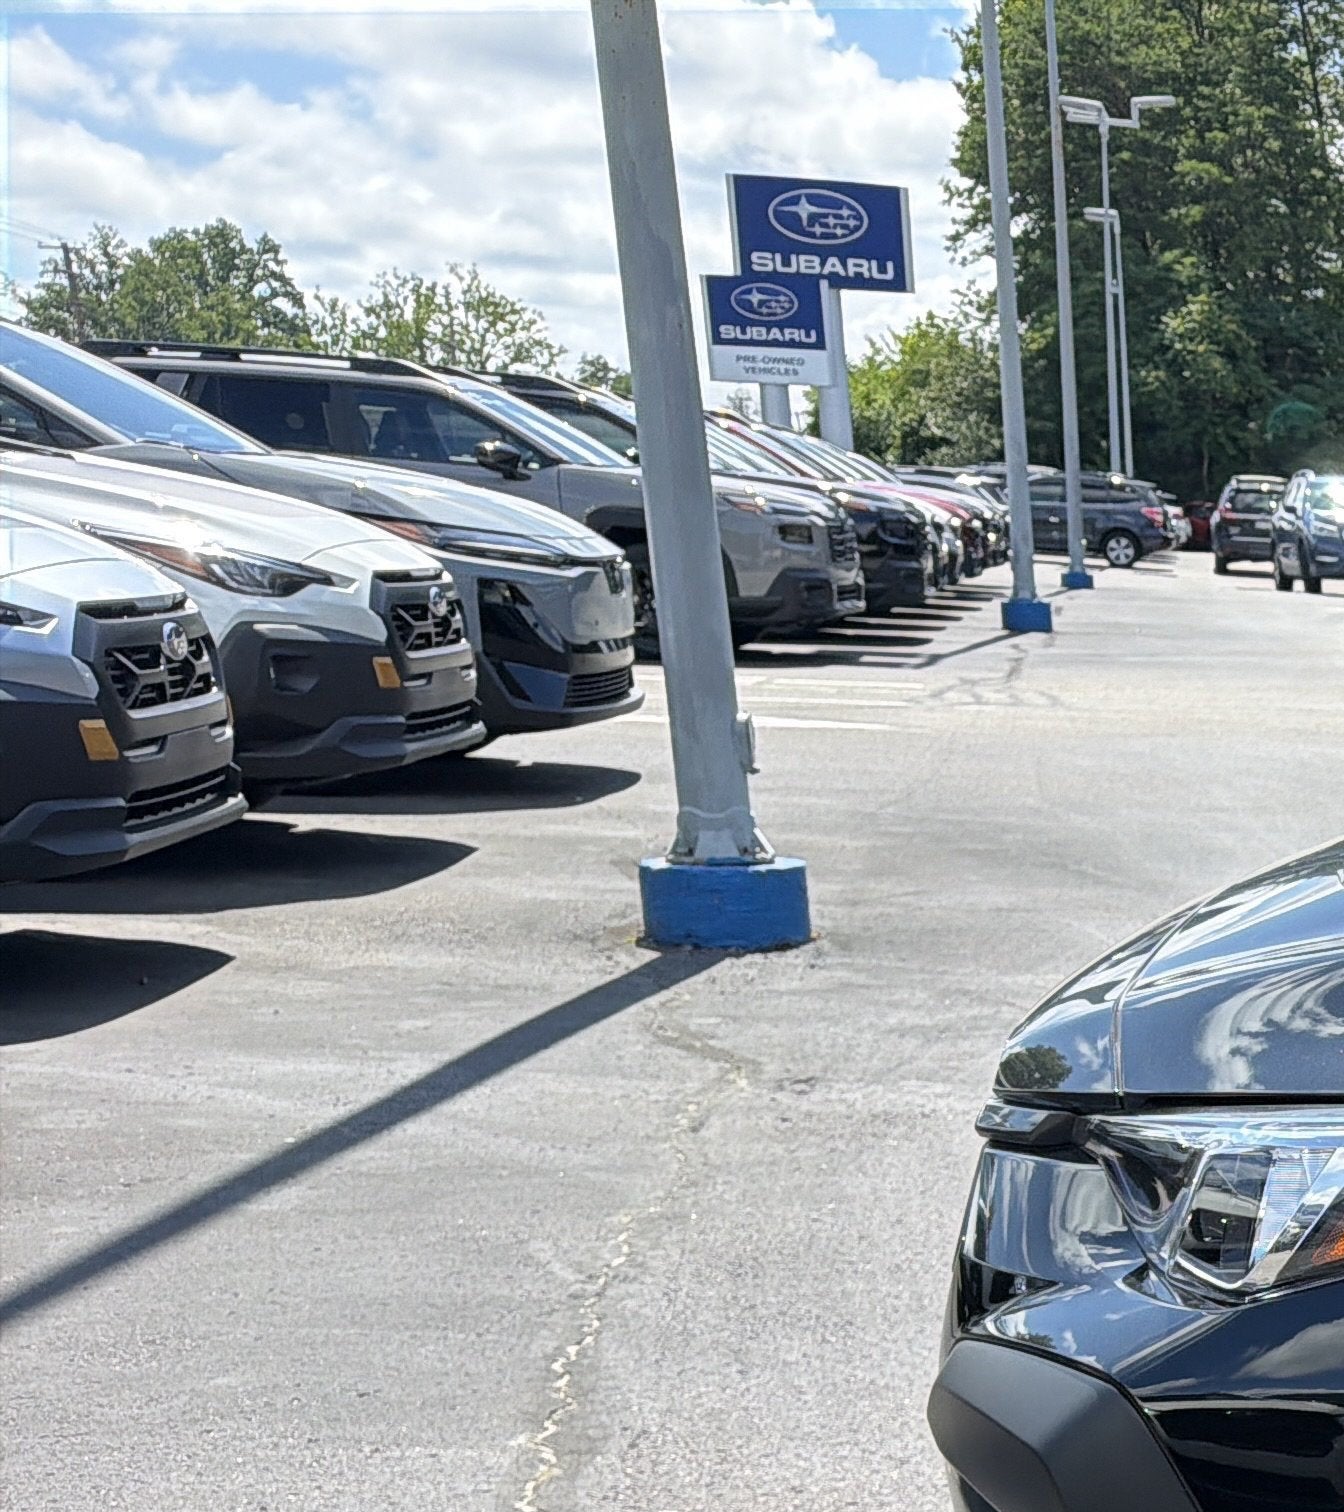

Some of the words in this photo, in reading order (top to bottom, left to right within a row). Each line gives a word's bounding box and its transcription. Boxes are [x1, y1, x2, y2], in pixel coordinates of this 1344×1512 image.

[750, 251, 895, 281] SUBARU
[718, 324, 818, 343] SUBARU
[735, 353, 806, 367] PRE-OWNED
[742, 365, 800, 377] VEHICLES
